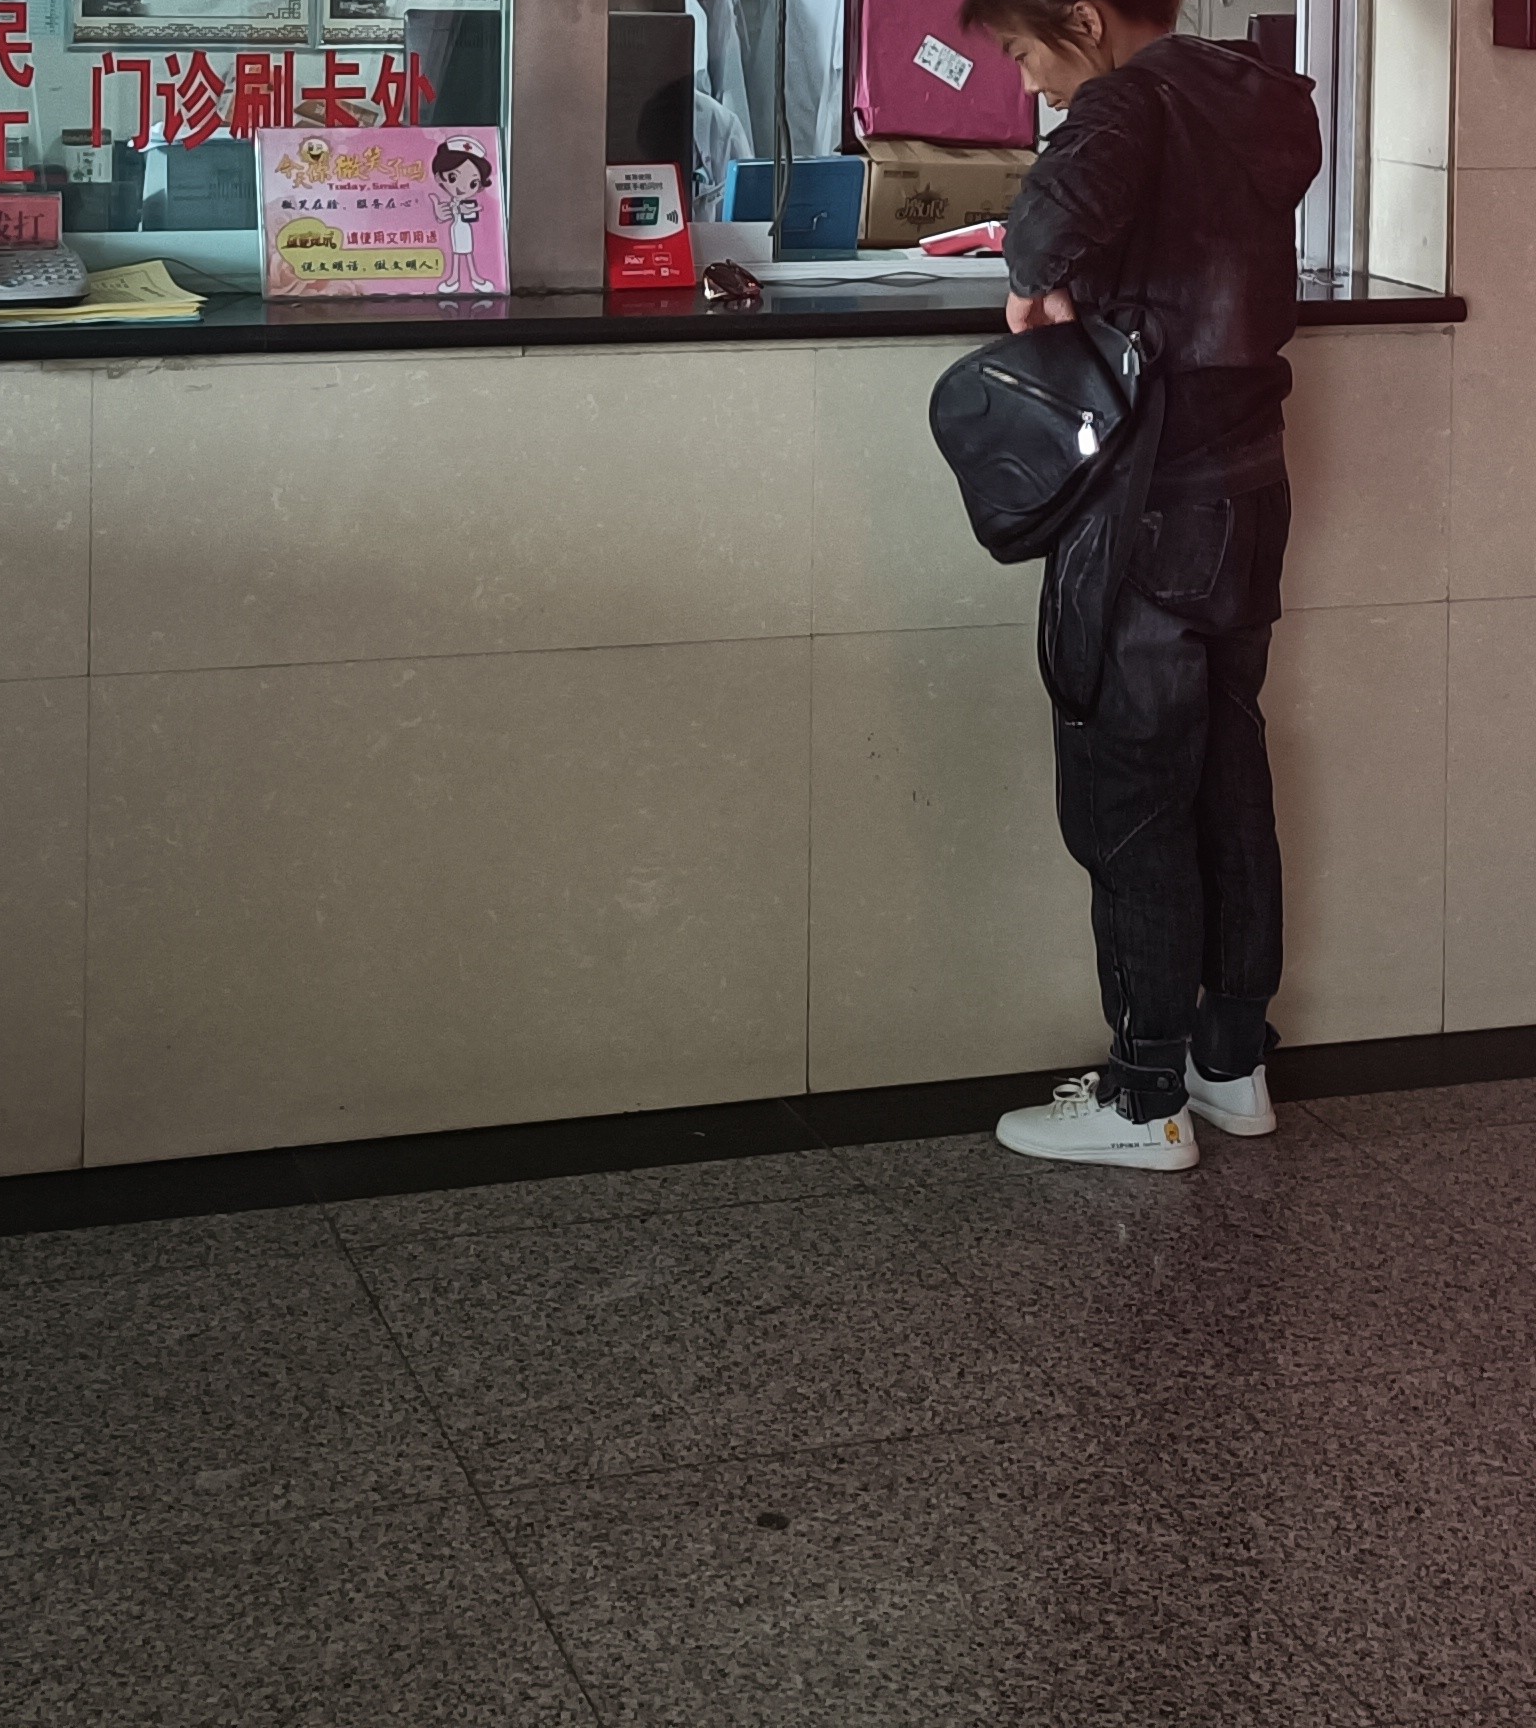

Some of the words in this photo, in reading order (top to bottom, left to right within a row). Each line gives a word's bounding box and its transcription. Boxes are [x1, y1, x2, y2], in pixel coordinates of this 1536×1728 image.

[91, 49, 438, 151] 门诊刷卡处
